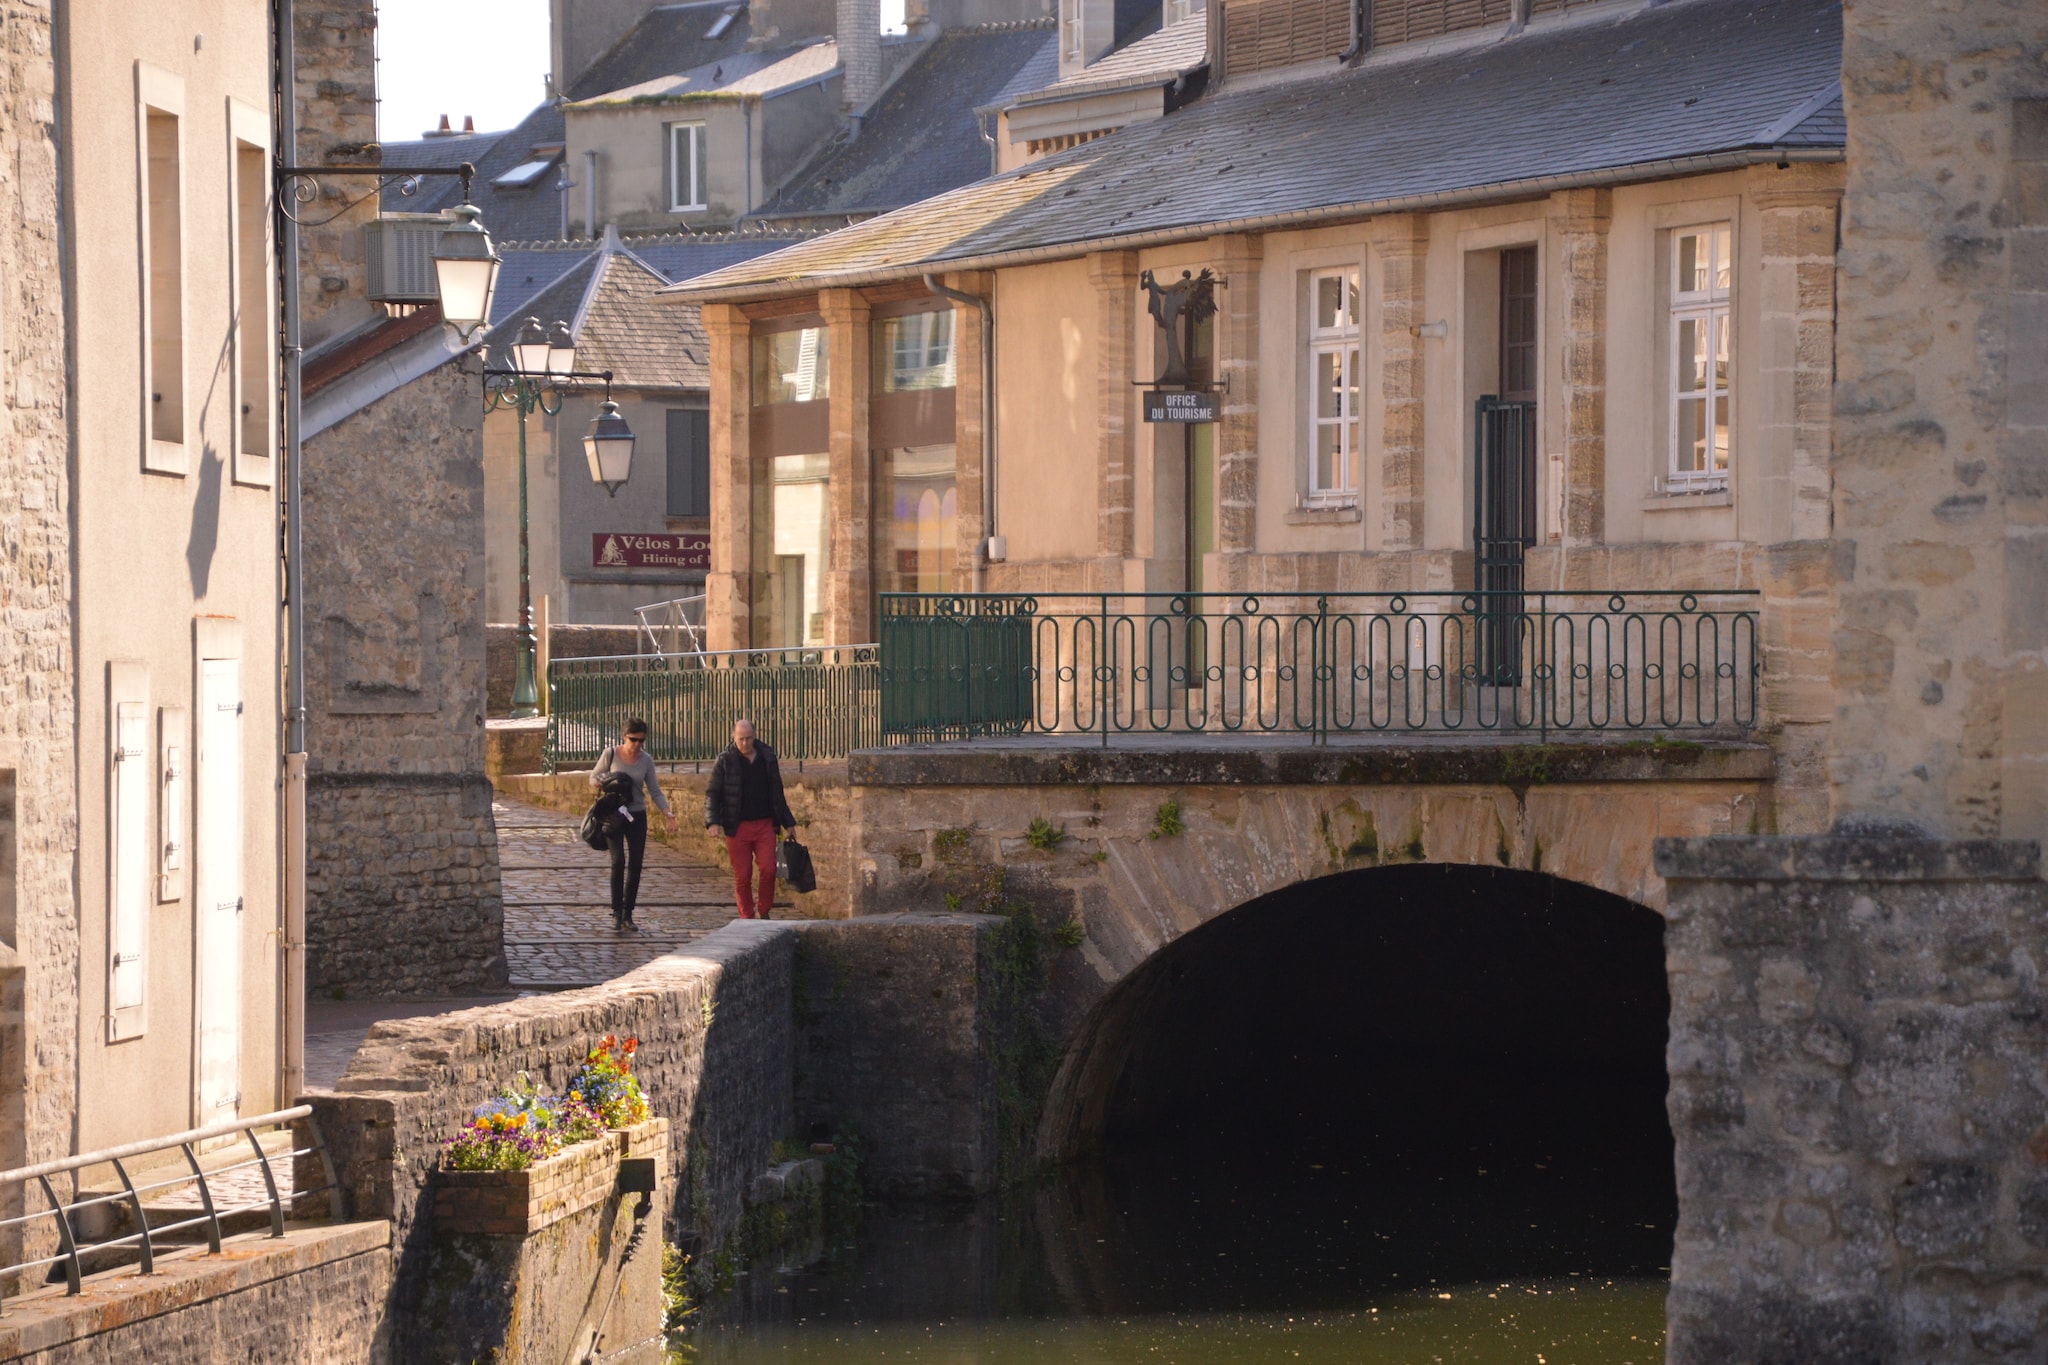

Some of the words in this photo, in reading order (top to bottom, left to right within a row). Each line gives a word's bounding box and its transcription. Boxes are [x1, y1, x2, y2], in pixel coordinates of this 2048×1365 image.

[1166, 395, 1196, 406] OFFICE
[1152, 408, 1163, 419] DU
[1168, 408, 1212, 419] TOURISME
[620, 535, 670, 549] Vélos
[642, 554, 685, 566] Hiring
[689, 554, 703, 564] of
